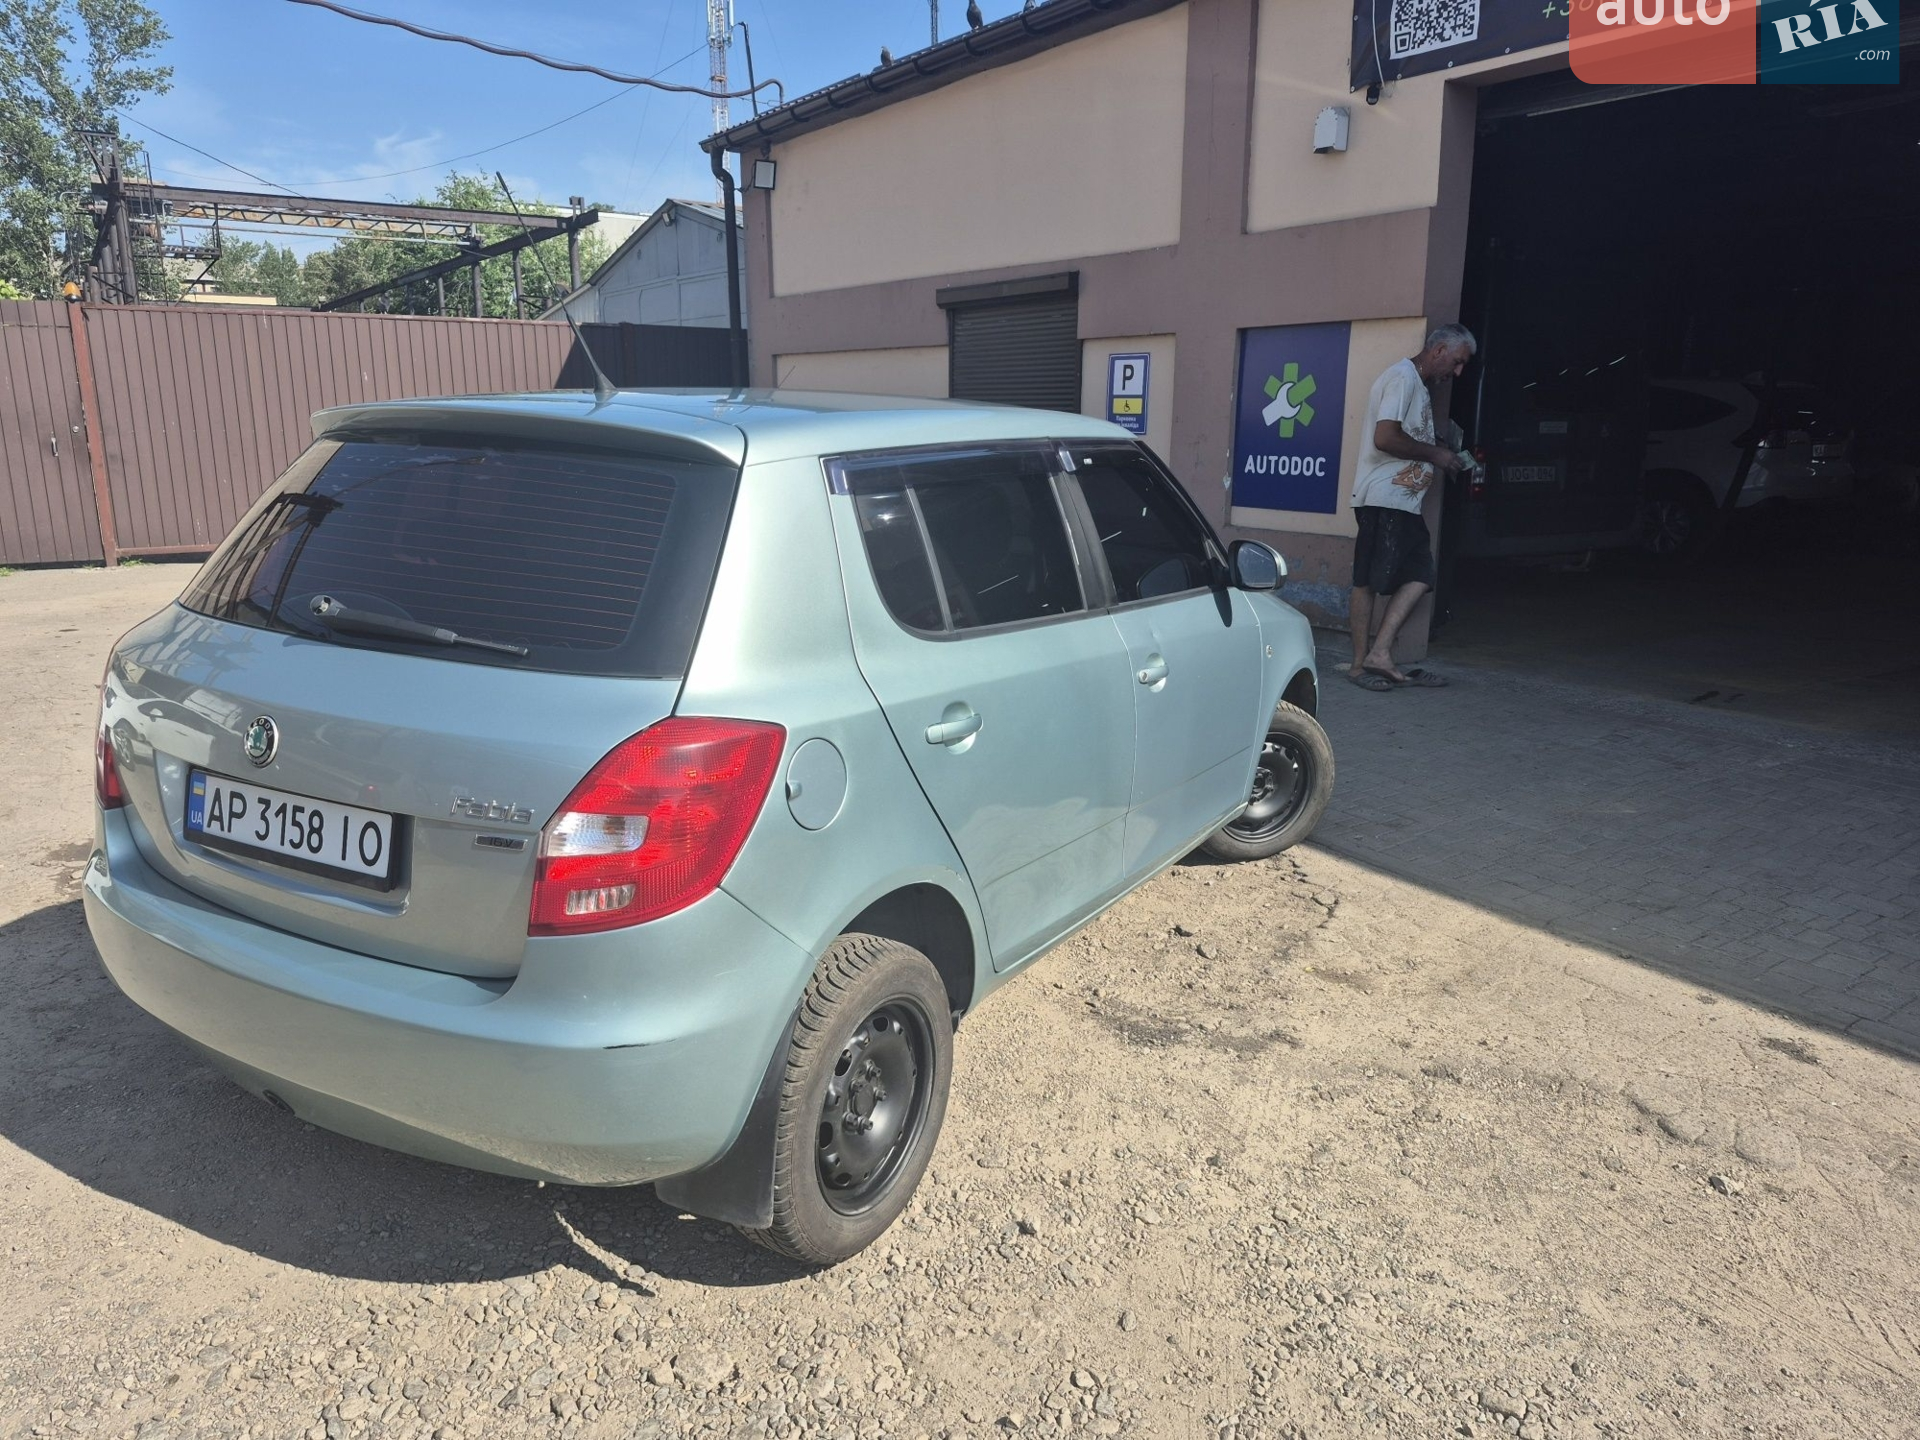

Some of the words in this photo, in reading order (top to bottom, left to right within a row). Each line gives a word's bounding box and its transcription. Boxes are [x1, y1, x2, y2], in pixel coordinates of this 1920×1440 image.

[1122, 364, 1134, 390] P
[1244, 454, 1326, 477] AUTODOC
[191, 810, 202, 824] UA
[451, 796, 535, 824] Fabia
[206, 787, 248, 834] AP
[254, 797, 324, 854] 3158
[340, 815, 383, 867] IO
